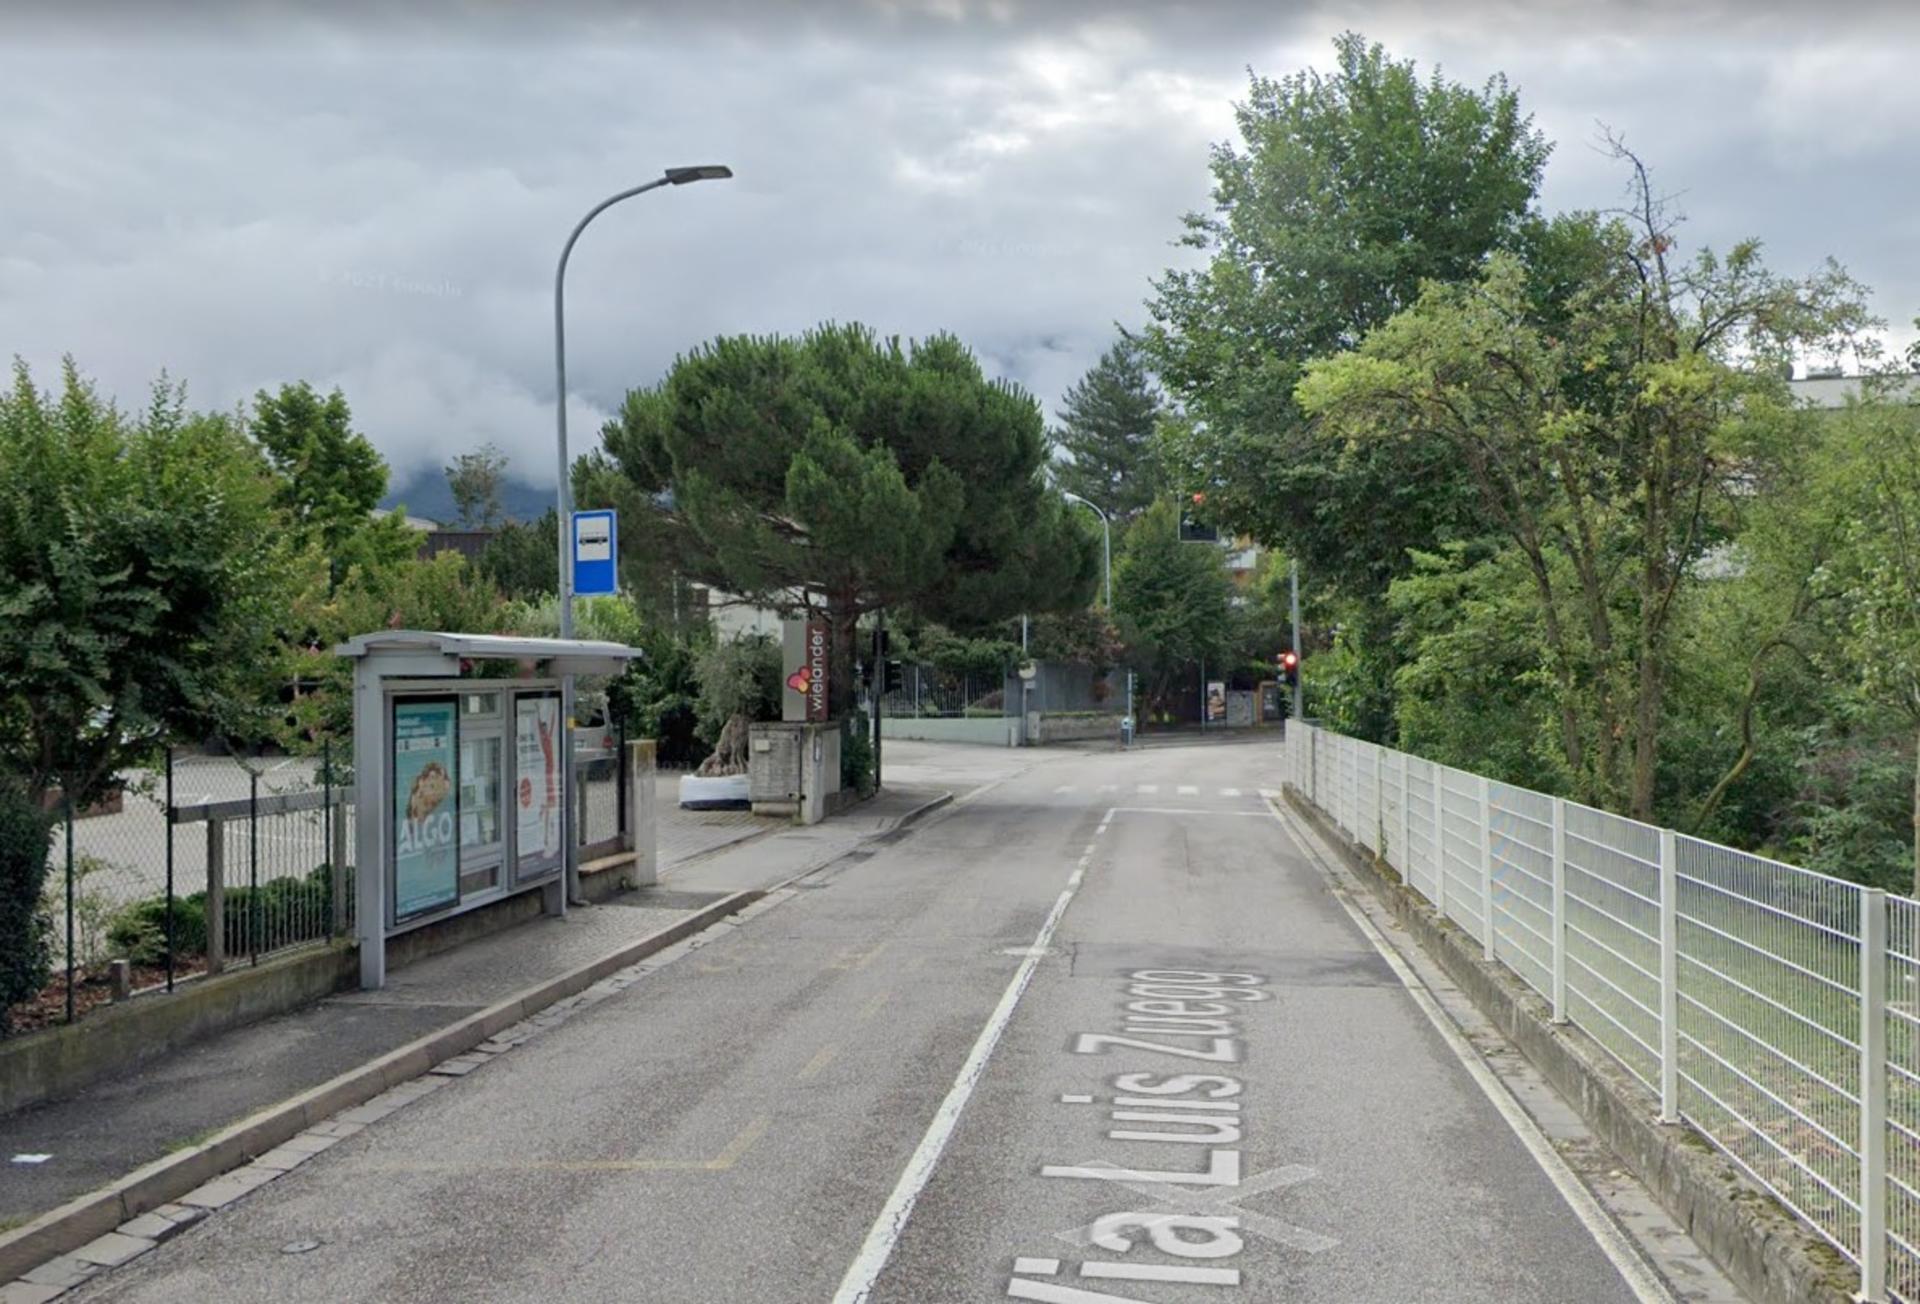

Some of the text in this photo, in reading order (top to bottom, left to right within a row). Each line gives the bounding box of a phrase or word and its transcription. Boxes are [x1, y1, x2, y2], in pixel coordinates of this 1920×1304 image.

[809, 629, 824, 712] wielander
[399, 811, 452, 853] ALGO
[1076, 969, 1267, 1062] Zuegg
[1041, 1073, 1242, 1186] Luis
